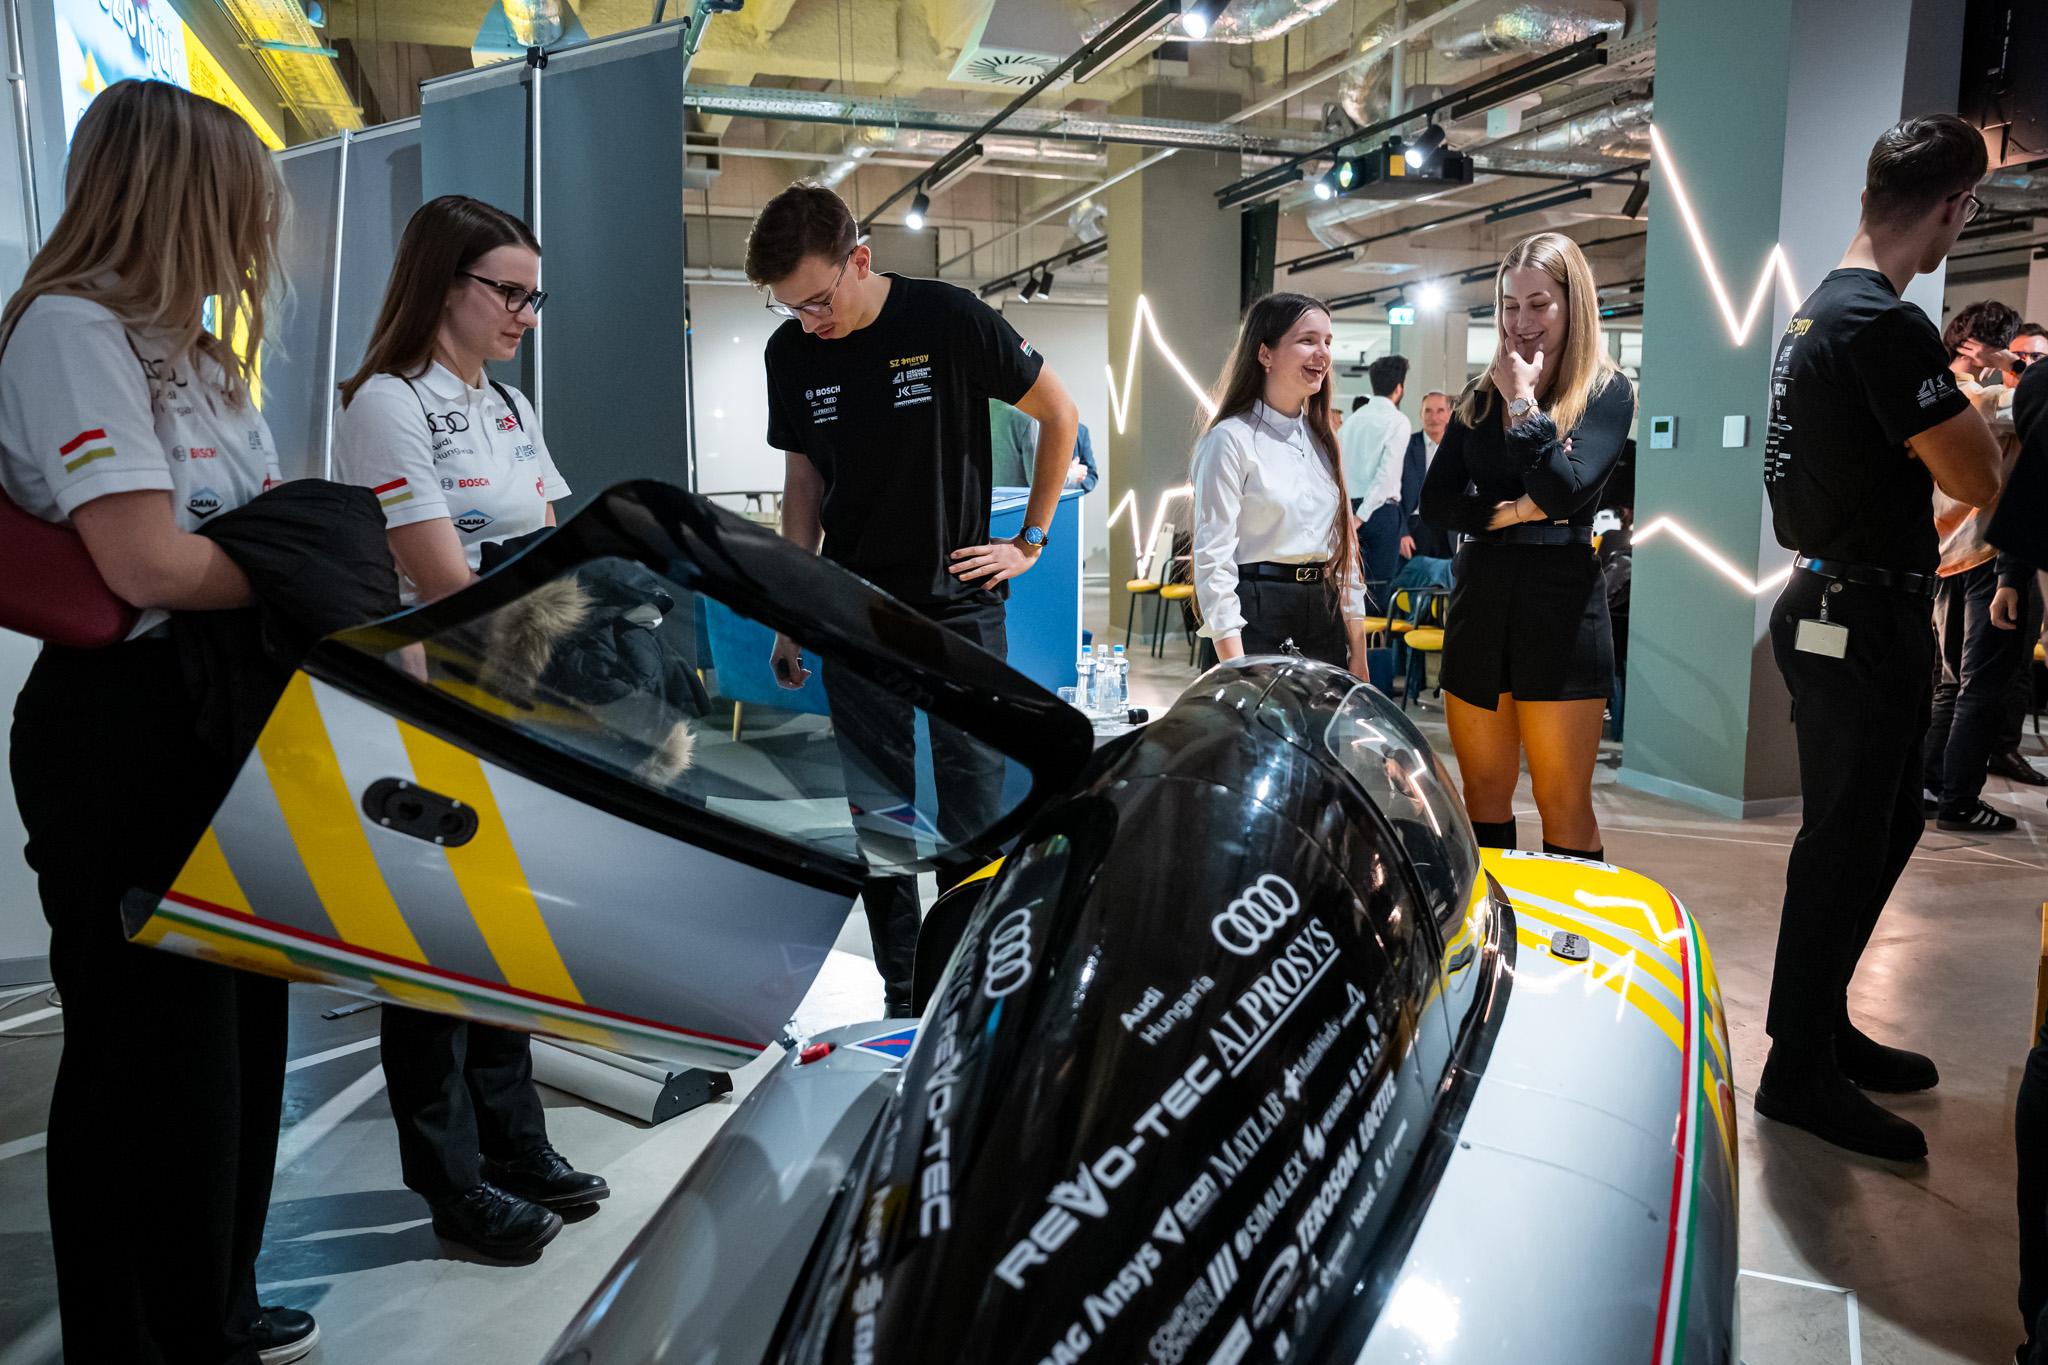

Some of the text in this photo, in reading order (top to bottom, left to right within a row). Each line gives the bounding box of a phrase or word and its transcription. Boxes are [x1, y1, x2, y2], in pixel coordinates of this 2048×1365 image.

[816, 385, 841, 397] BOSCH
[190, 499, 218, 508] DANA
[458, 477, 490, 489] BOSCH
[458, 518, 486, 526] DANA
[1120, 985, 1165, 1032] Audi
[1139, 975, 1216, 1046] Hungaria
[1209, 917, 1337, 1070] ALPROSYS
[1350, 1037, 1381, 1089] BETA
[919, 1010, 962, 1238] REVO-TEC
[1358, 1069, 1397, 1153] LOCTITE
[994, 1053, 1223, 1290] REVO-TEC
[1245, 1150, 1308, 1245] SIMULEX
[1296, 1137, 1361, 1255] TEROSON
[1083, 1241, 1162, 1334] Ansys
